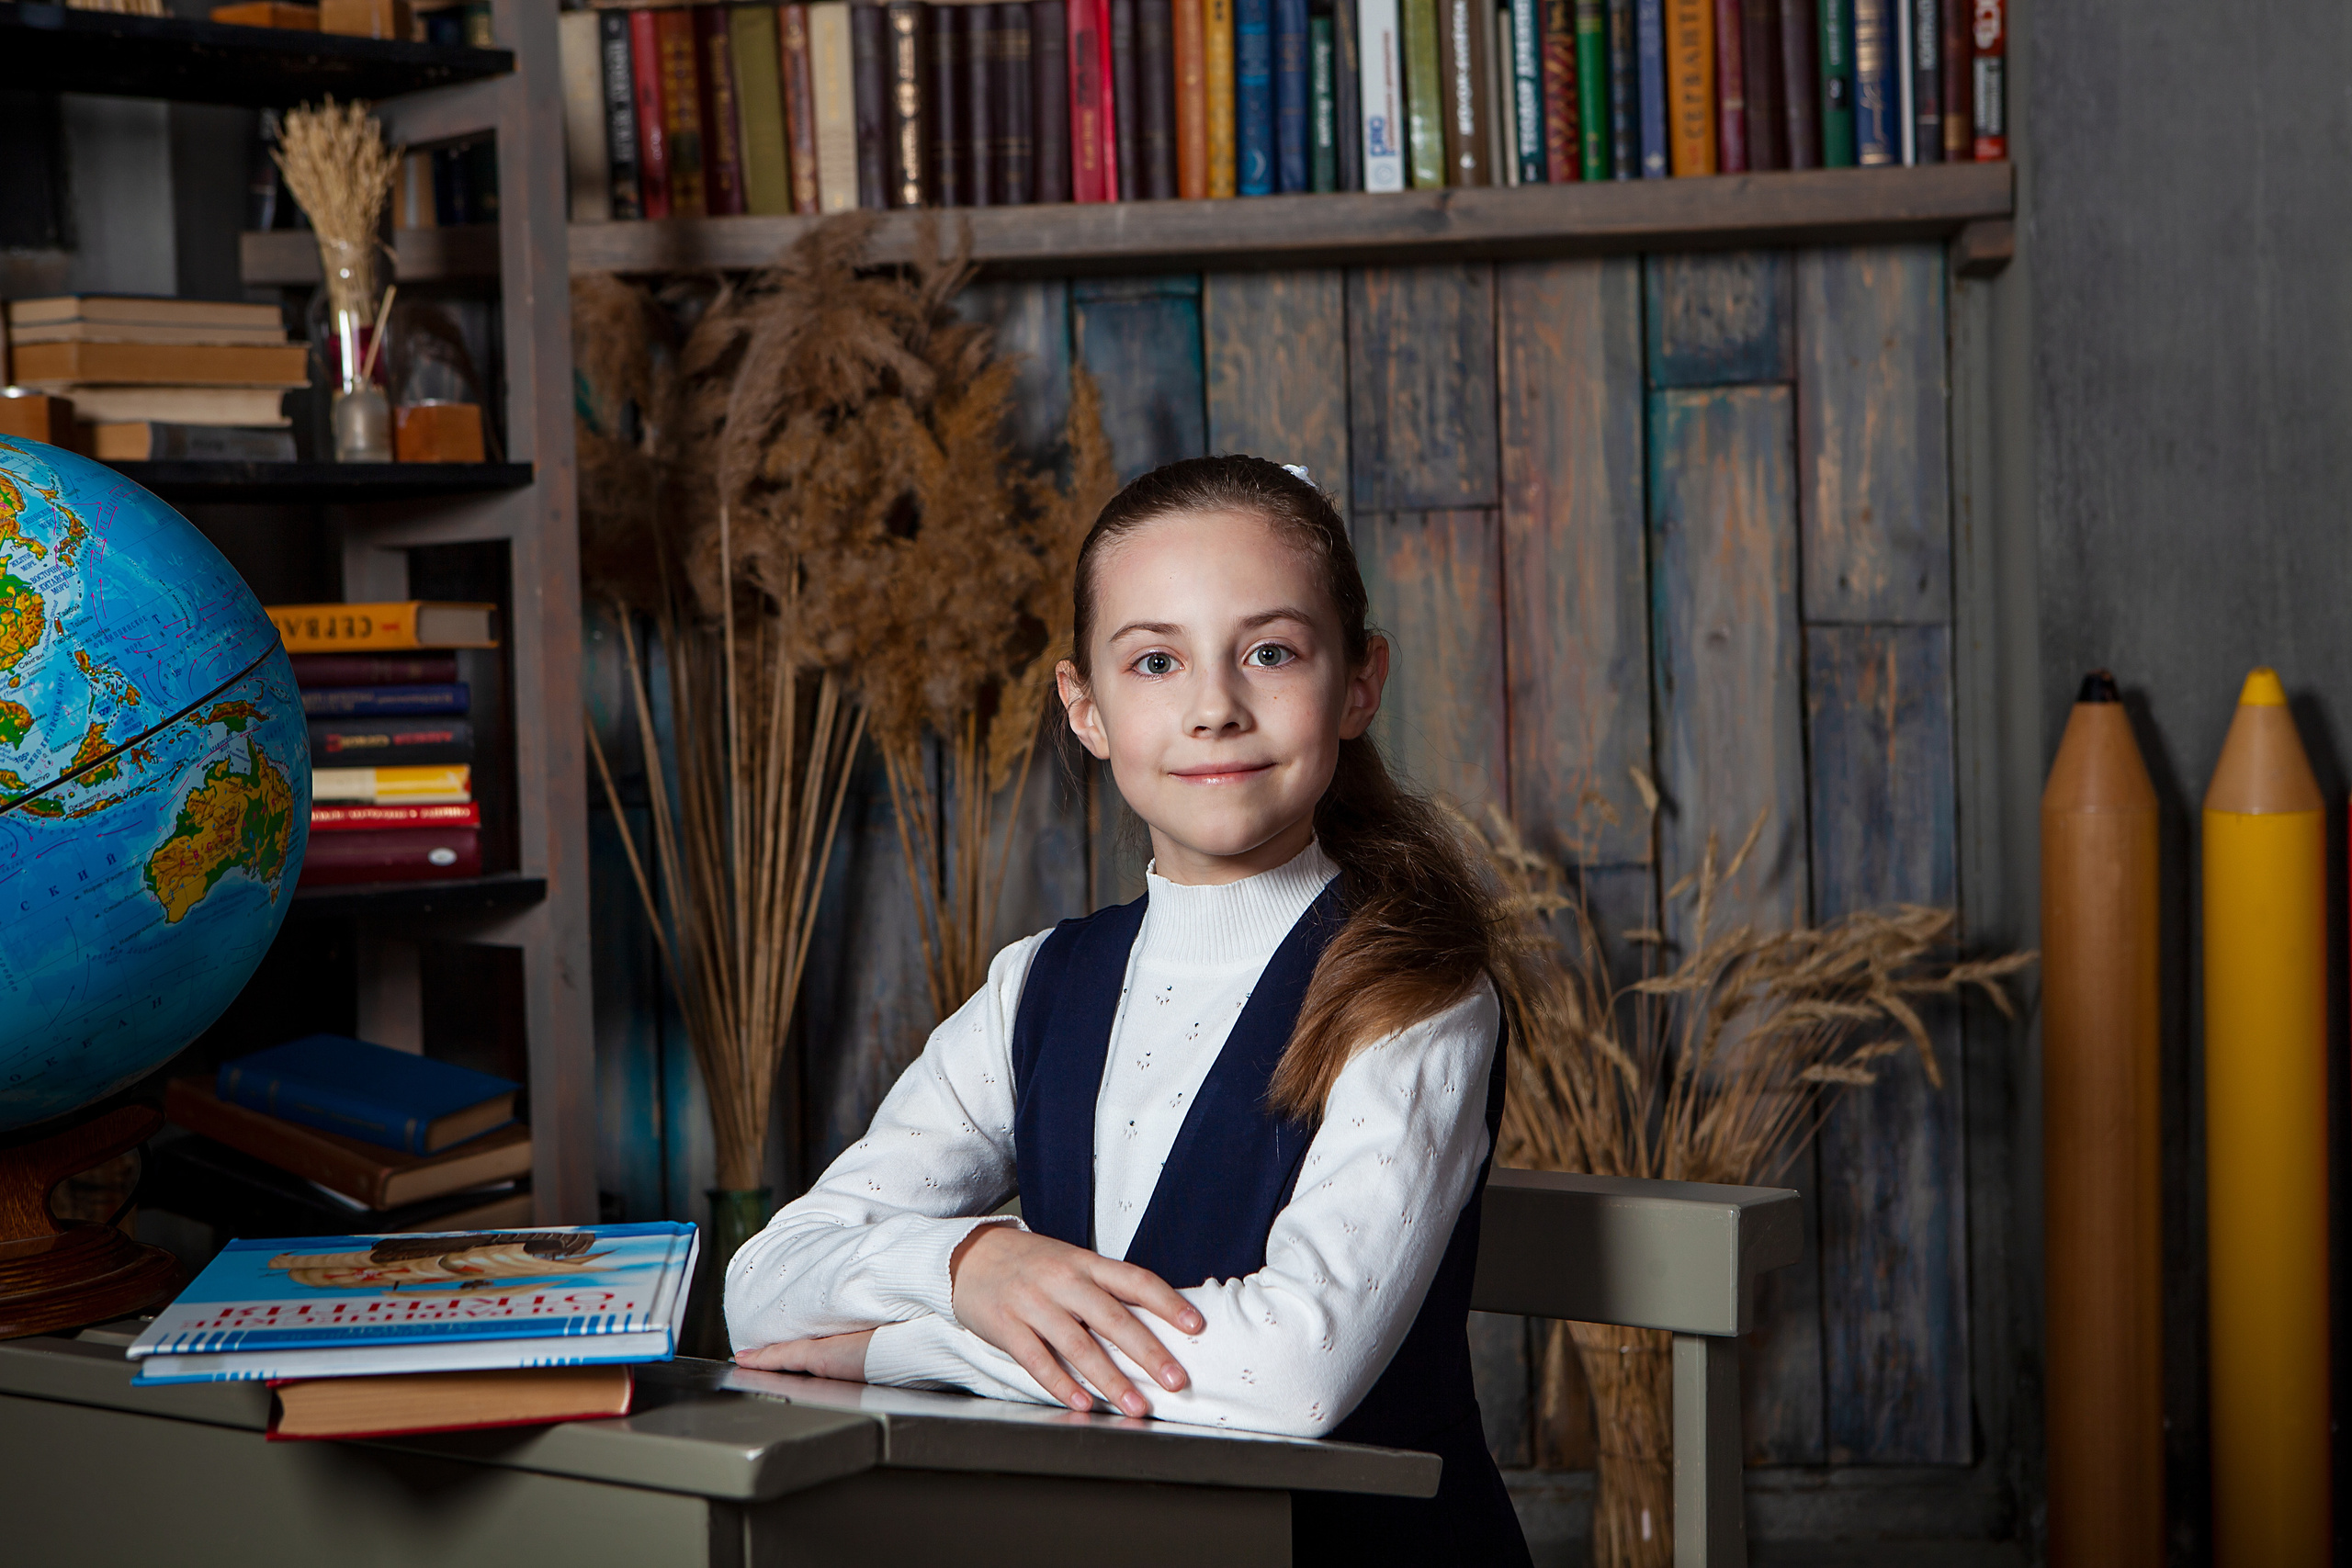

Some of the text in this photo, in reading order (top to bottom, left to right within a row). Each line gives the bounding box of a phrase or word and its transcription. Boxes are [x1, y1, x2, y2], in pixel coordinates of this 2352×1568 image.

[23, 507, 55, 525] ЯПОНСКОЕ
[39, 517, 56, 530] МОРЕ
[9, 552, 32, 568] ЖЕЛТОЕ
[20, 559, 38, 572] МОРЕ
[51, 581, 70, 595] МОРЕ
[57, 604, 81, 618] Тайбэй
[71, 615, 94, 629] Тайвань
[94, 615, 148, 649] ФИЛИППИНСКОЕ
[125, 641, 143, 654] МОРЕ
[18, 653, 45, 670] Сянган
[57, 671, 66, 696] МОРЕ
[14, 751, 30, 764] 105°
[68, 792, 101, 811] Джакарта
[179, 796, 277, 868] АВСТРАЛИЯ
[218, 1292, 616, 1319] ОТКРЫТИЯ
[179, 1301, 634, 1330] ГЕОГРАФИЧЕСКИЕ
